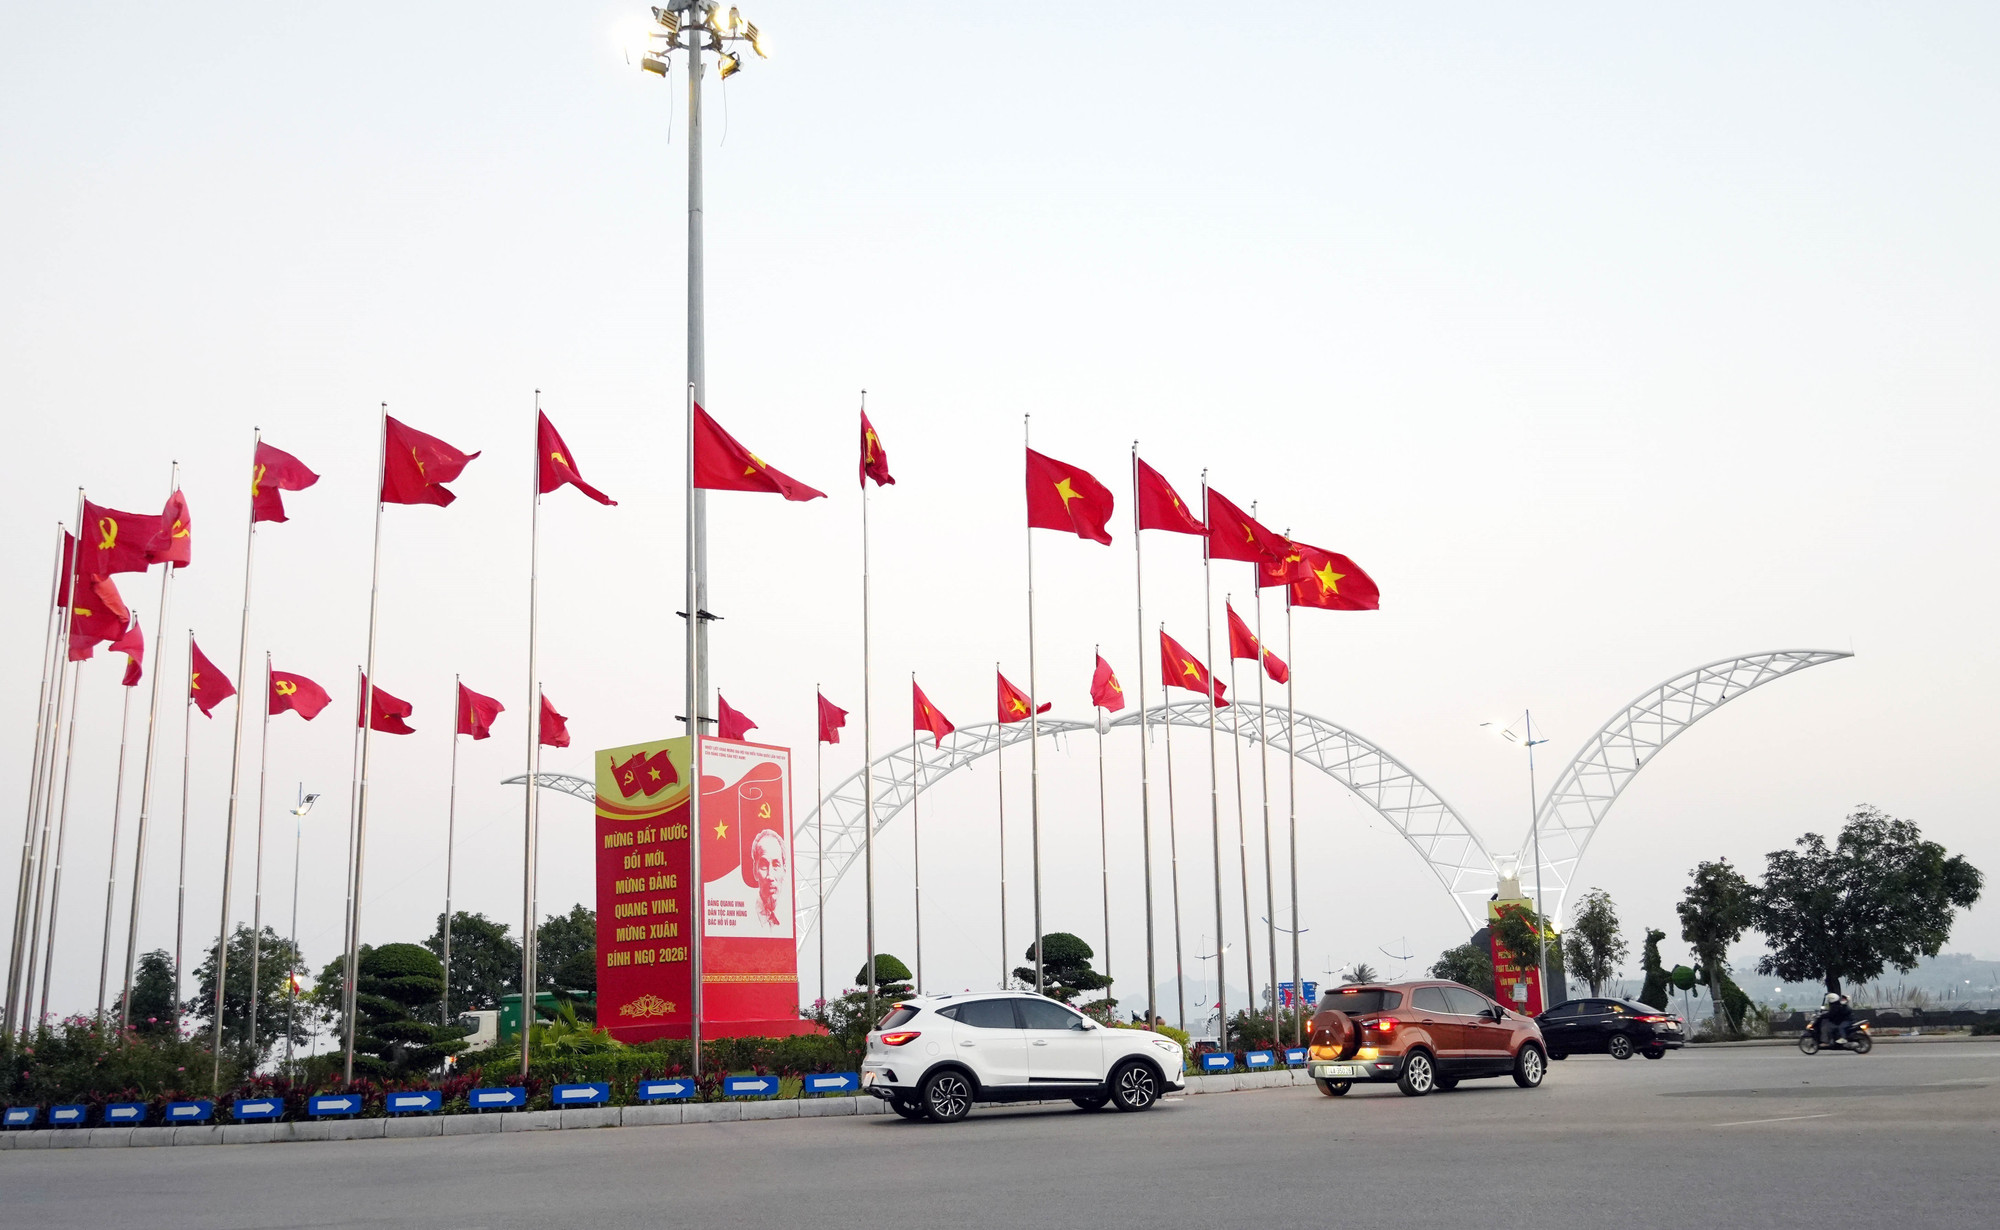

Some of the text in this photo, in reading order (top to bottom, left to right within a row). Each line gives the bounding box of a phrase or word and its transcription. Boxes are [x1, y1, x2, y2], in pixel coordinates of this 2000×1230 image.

[604, 822, 688, 849] MỪNG ĐẤT NƯỚC
[624, 849, 668, 870] ĐỔI MỚI,
[616, 872, 677, 894] MỪNG ĐẢNG
[615, 898, 678, 920] QUANG VINH,
[616, 920, 678, 942] MỪNG XUÂN
[608, 946, 688, 967] BÍNH NGỌ 2026!
